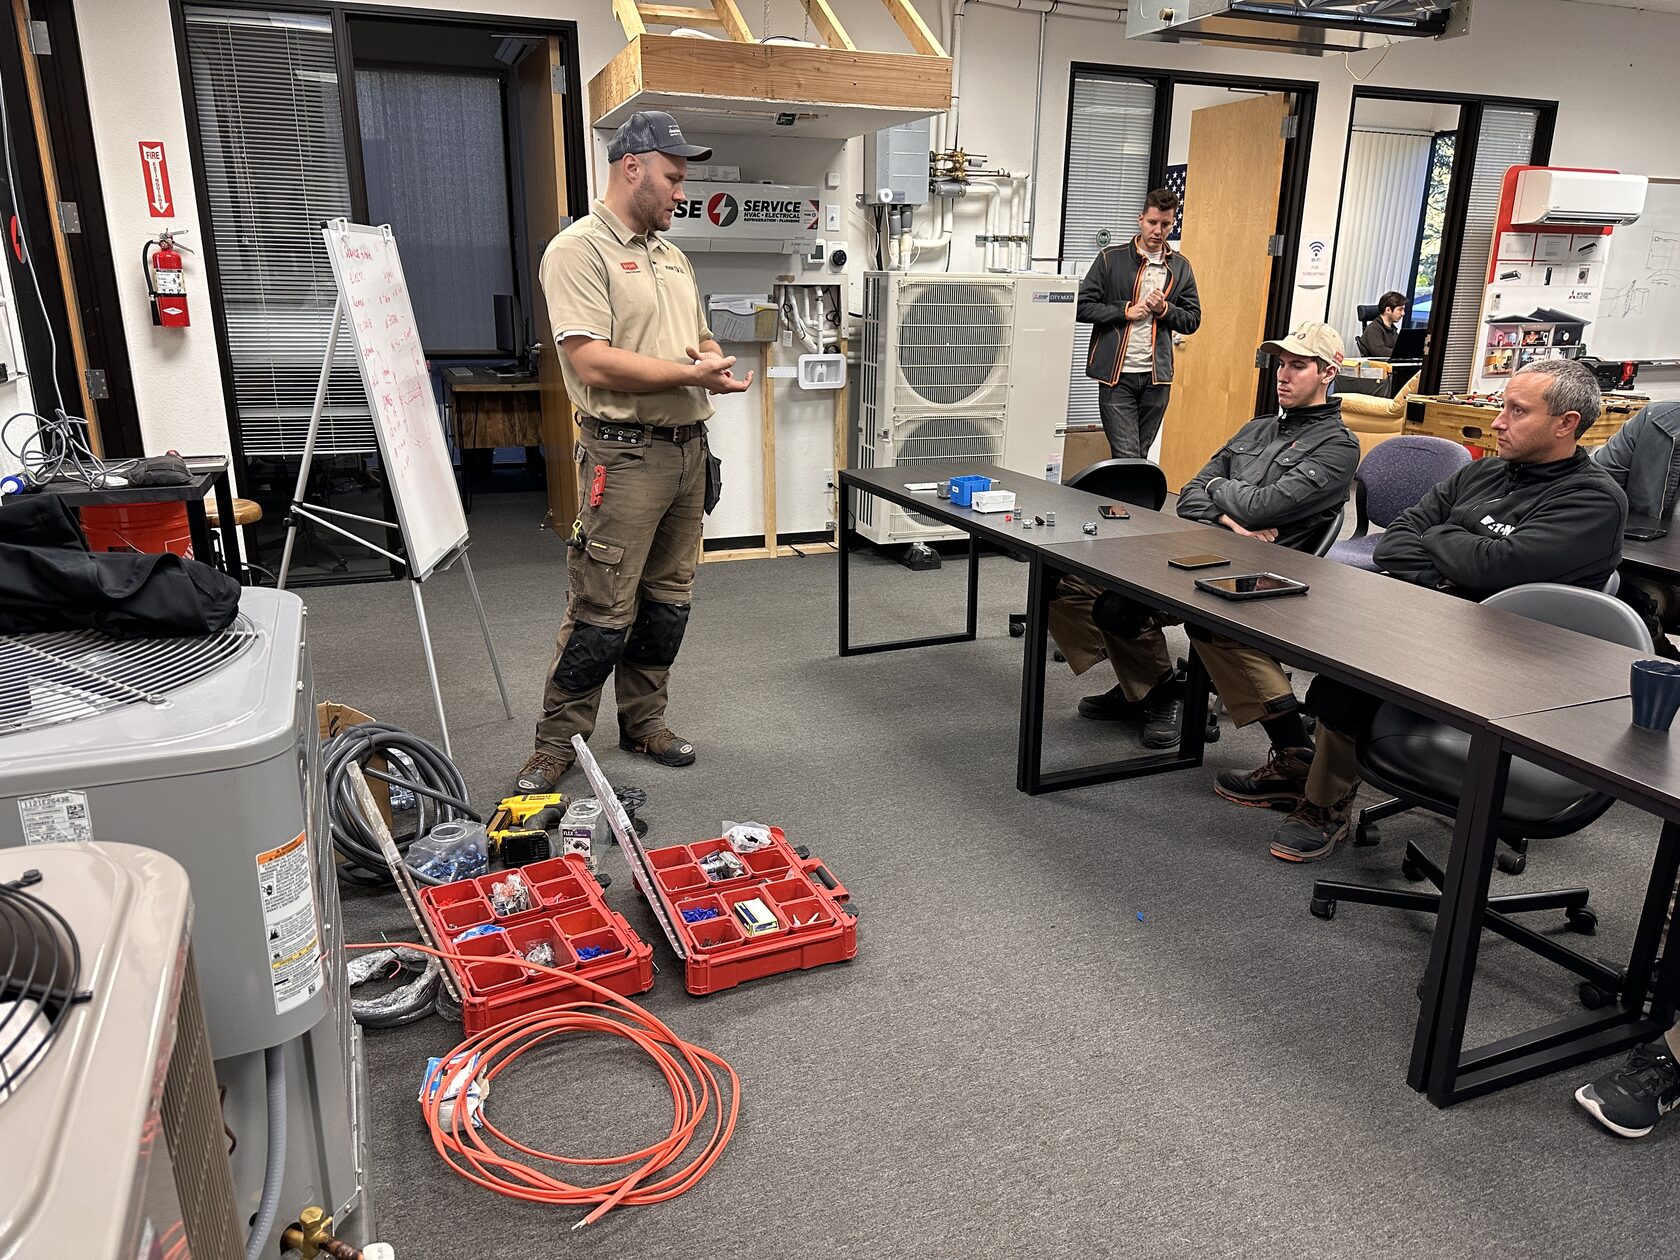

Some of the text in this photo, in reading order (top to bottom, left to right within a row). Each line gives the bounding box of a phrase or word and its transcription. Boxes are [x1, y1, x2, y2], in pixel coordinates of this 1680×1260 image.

[146, 151, 160, 160] FIRE
[673, 200, 703, 218] SE
[743, 199, 802, 213] SERVICE
